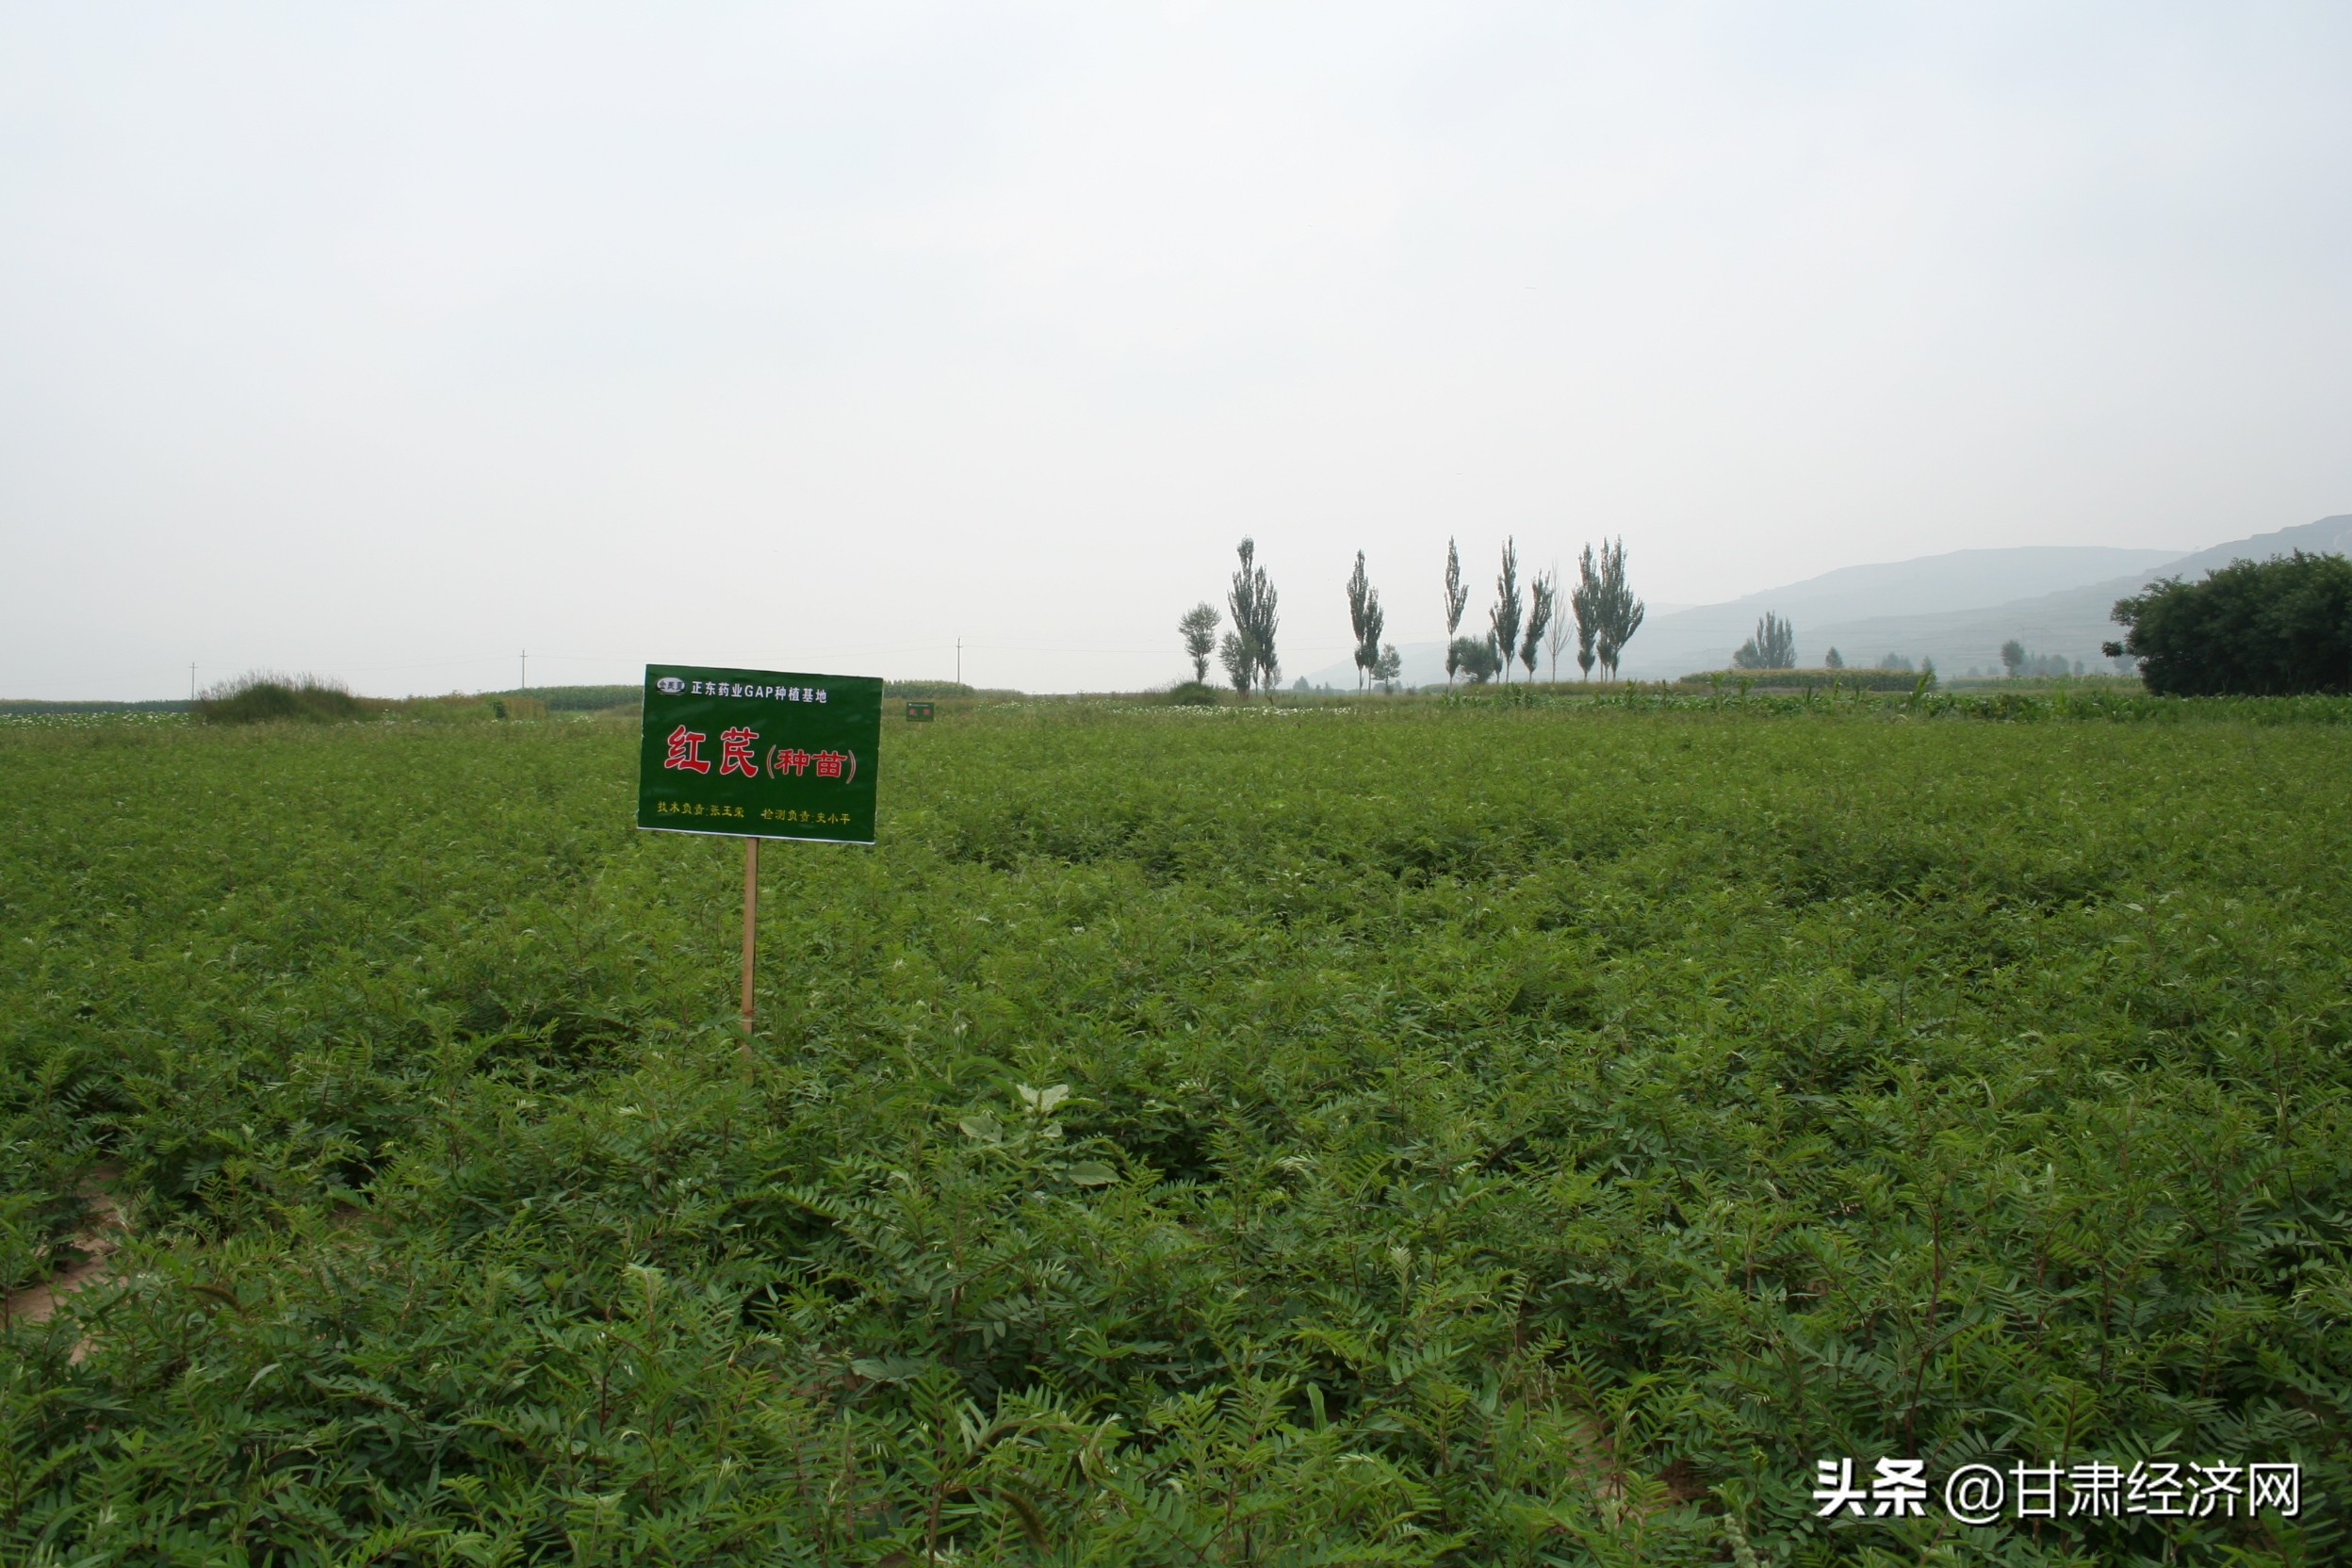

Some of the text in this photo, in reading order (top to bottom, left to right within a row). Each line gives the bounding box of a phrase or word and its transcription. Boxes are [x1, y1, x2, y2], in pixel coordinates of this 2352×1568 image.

[691, 680, 827, 703] 正东药业GAP种植基地
